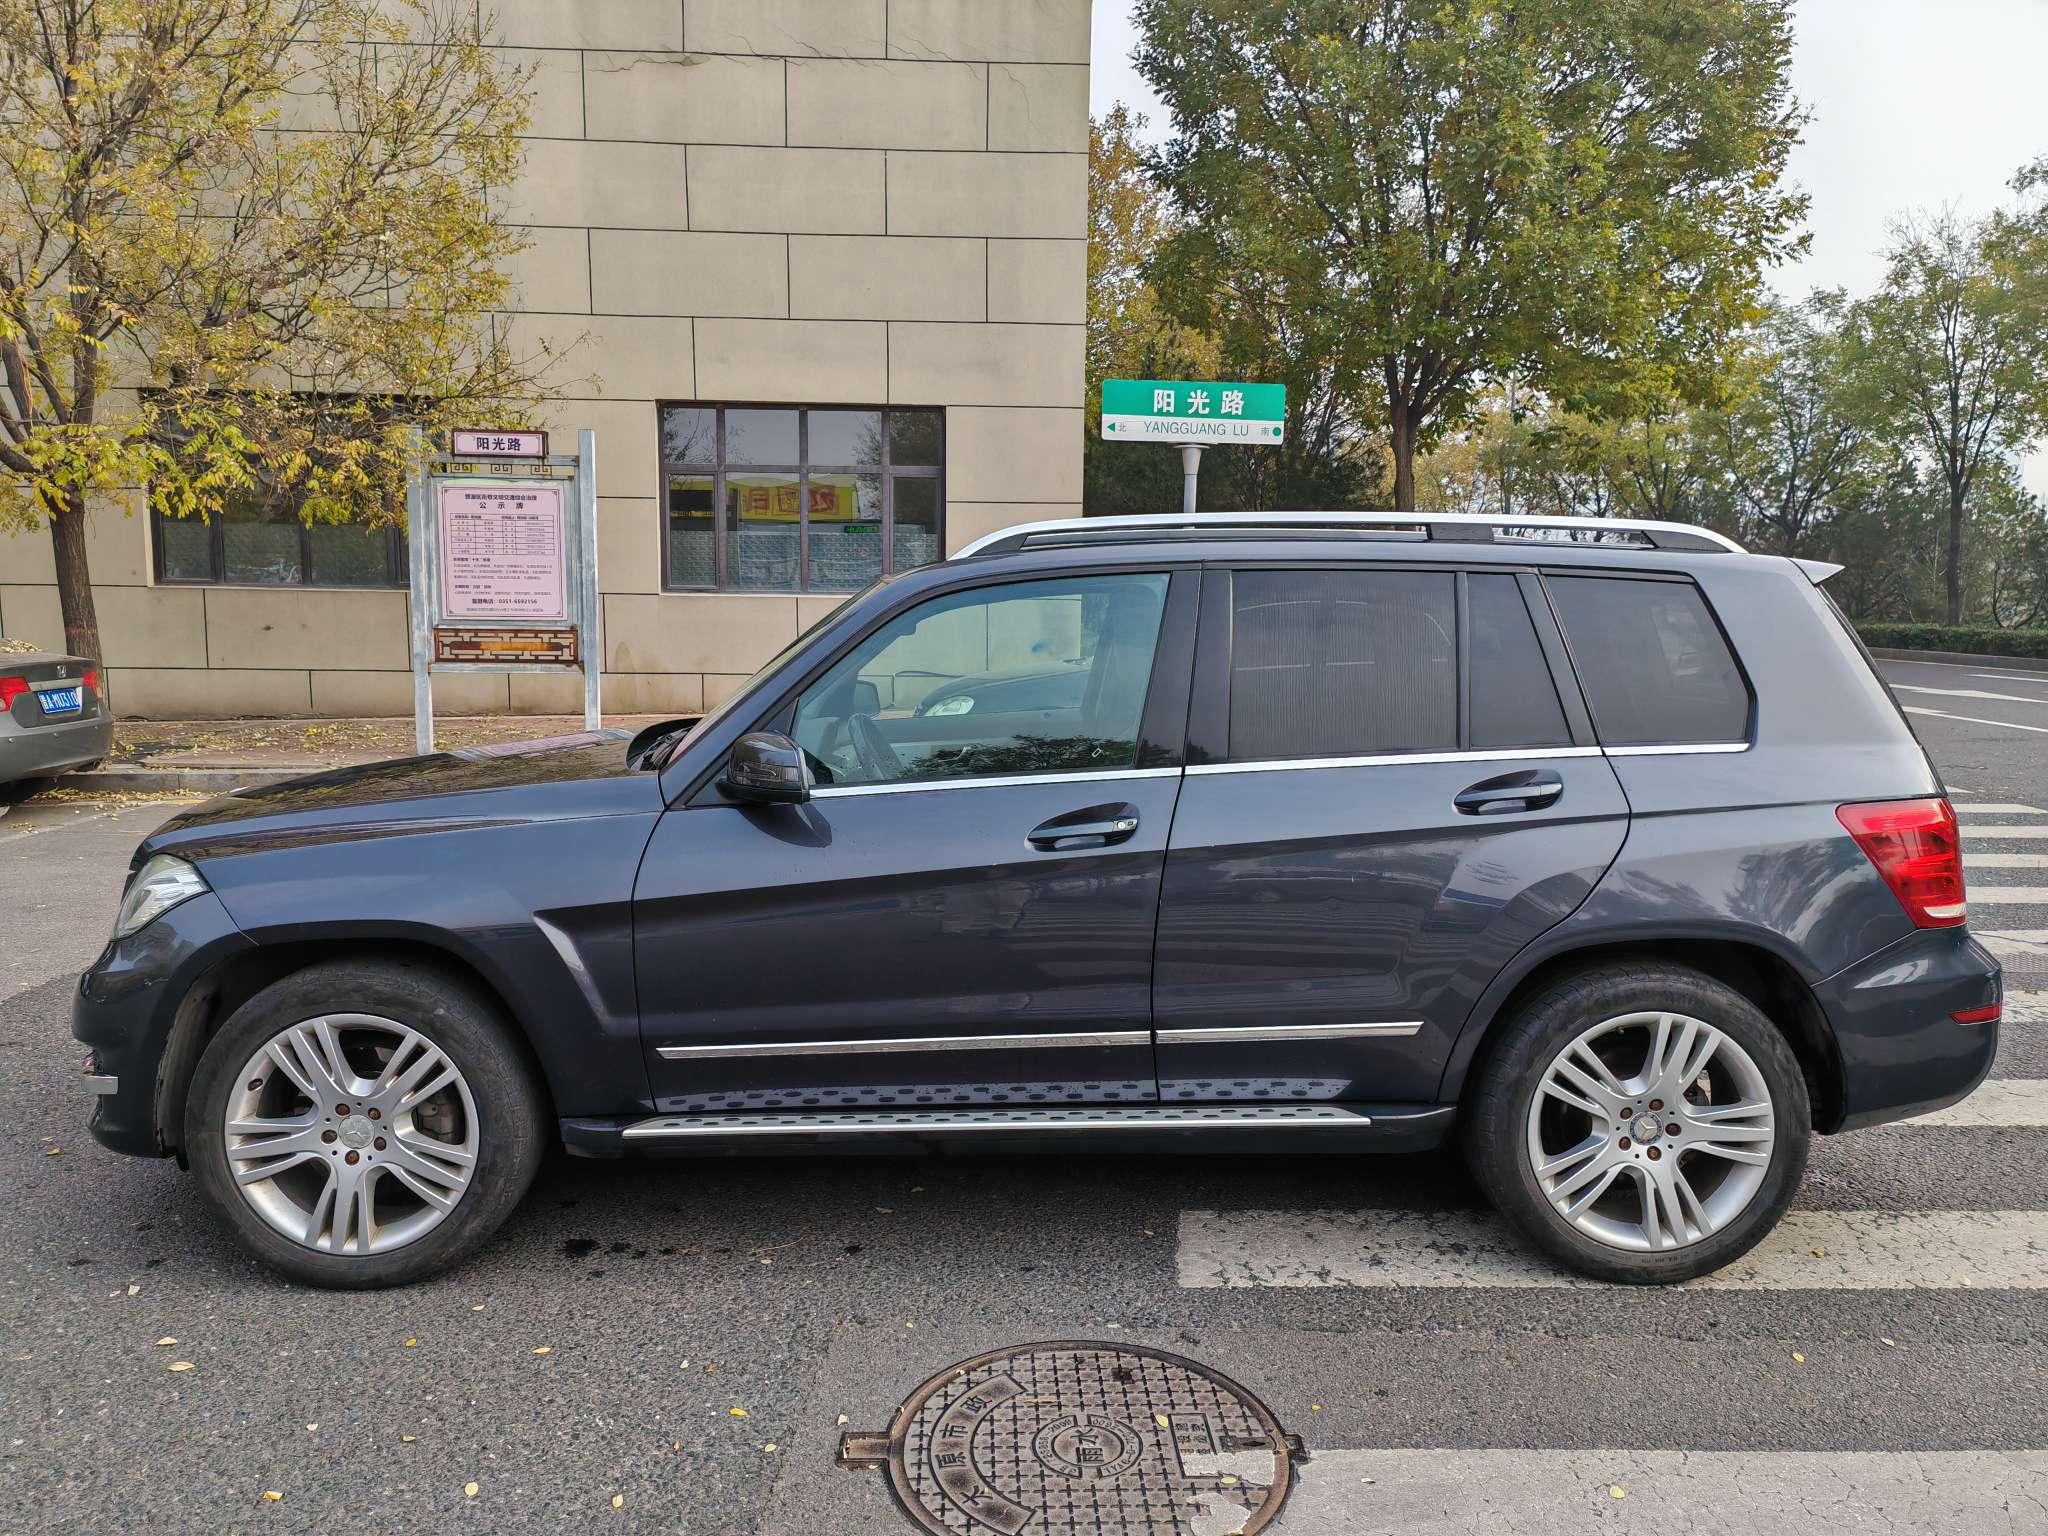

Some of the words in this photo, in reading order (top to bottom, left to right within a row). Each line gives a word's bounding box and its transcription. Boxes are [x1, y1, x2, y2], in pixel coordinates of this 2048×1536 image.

[1153, 389, 1245, 416] 阳光路
[1118, 422, 1127, 433] 北
[1143, 421, 1226, 436] YANGGUANG
[1233, 424, 1249, 437] LU
[1261, 426, 1270, 437] 南
[476, 436, 521, 452] 阳光路
[479, 501, 524, 510] 公示牌
[1070, 1427, 1106, 1465] 雨水
